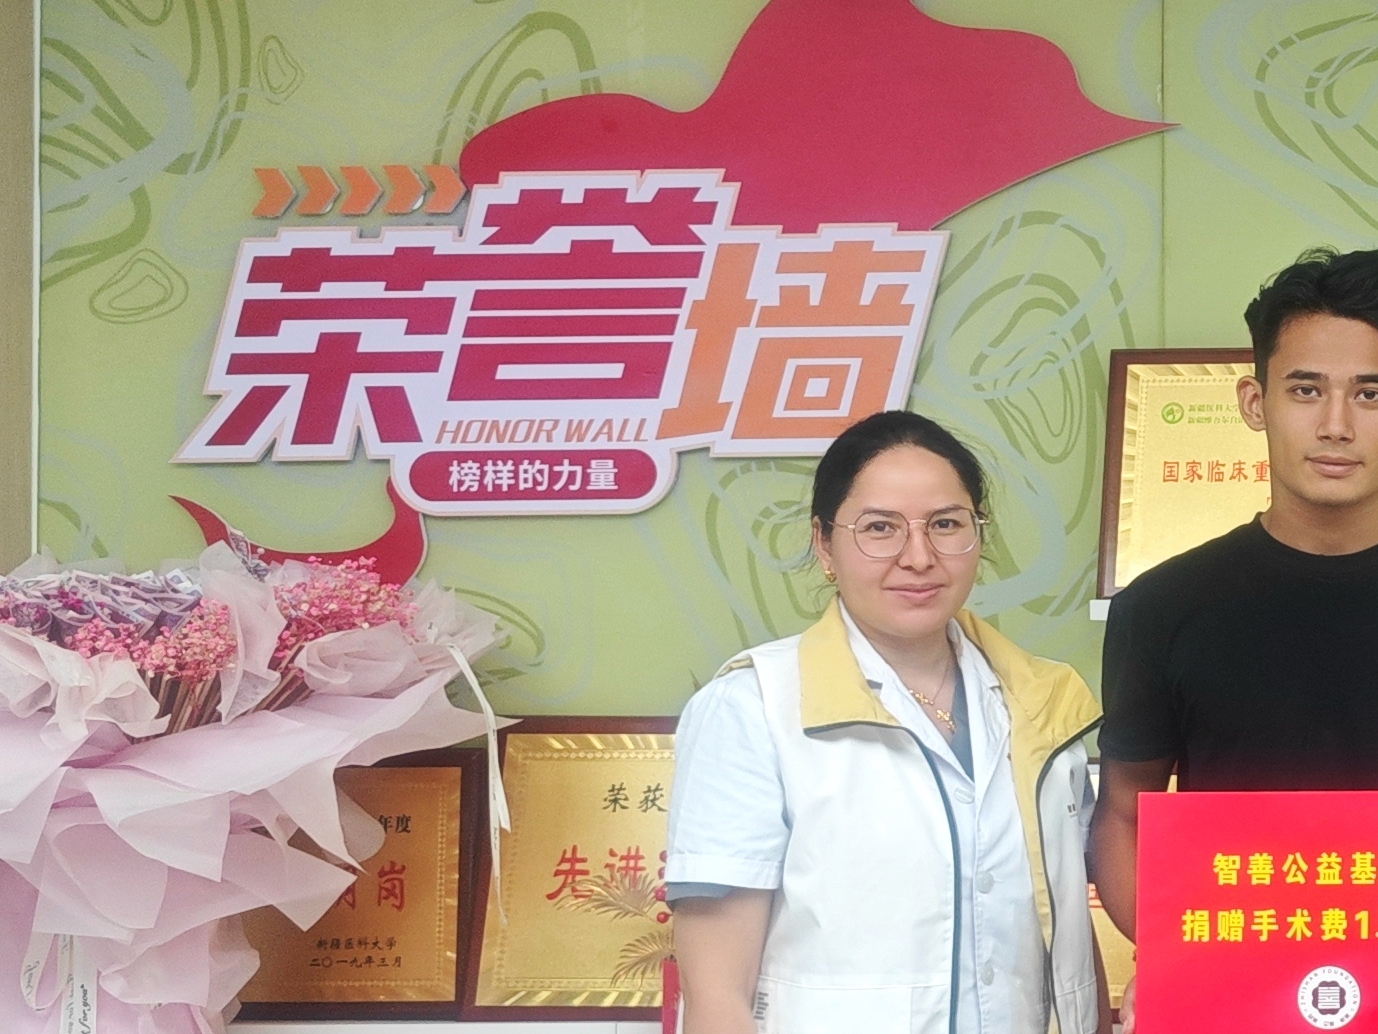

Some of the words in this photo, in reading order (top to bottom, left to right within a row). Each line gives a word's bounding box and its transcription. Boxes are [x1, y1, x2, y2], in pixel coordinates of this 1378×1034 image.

[206, 186, 926, 446] 荣誉墙
[435, 419, 560, 444] HONOR
[564, 418, 649, 442] WALL
[449, 459, 619, 492] 榜样的力量
[602, 782, 669, 813] 荣获
